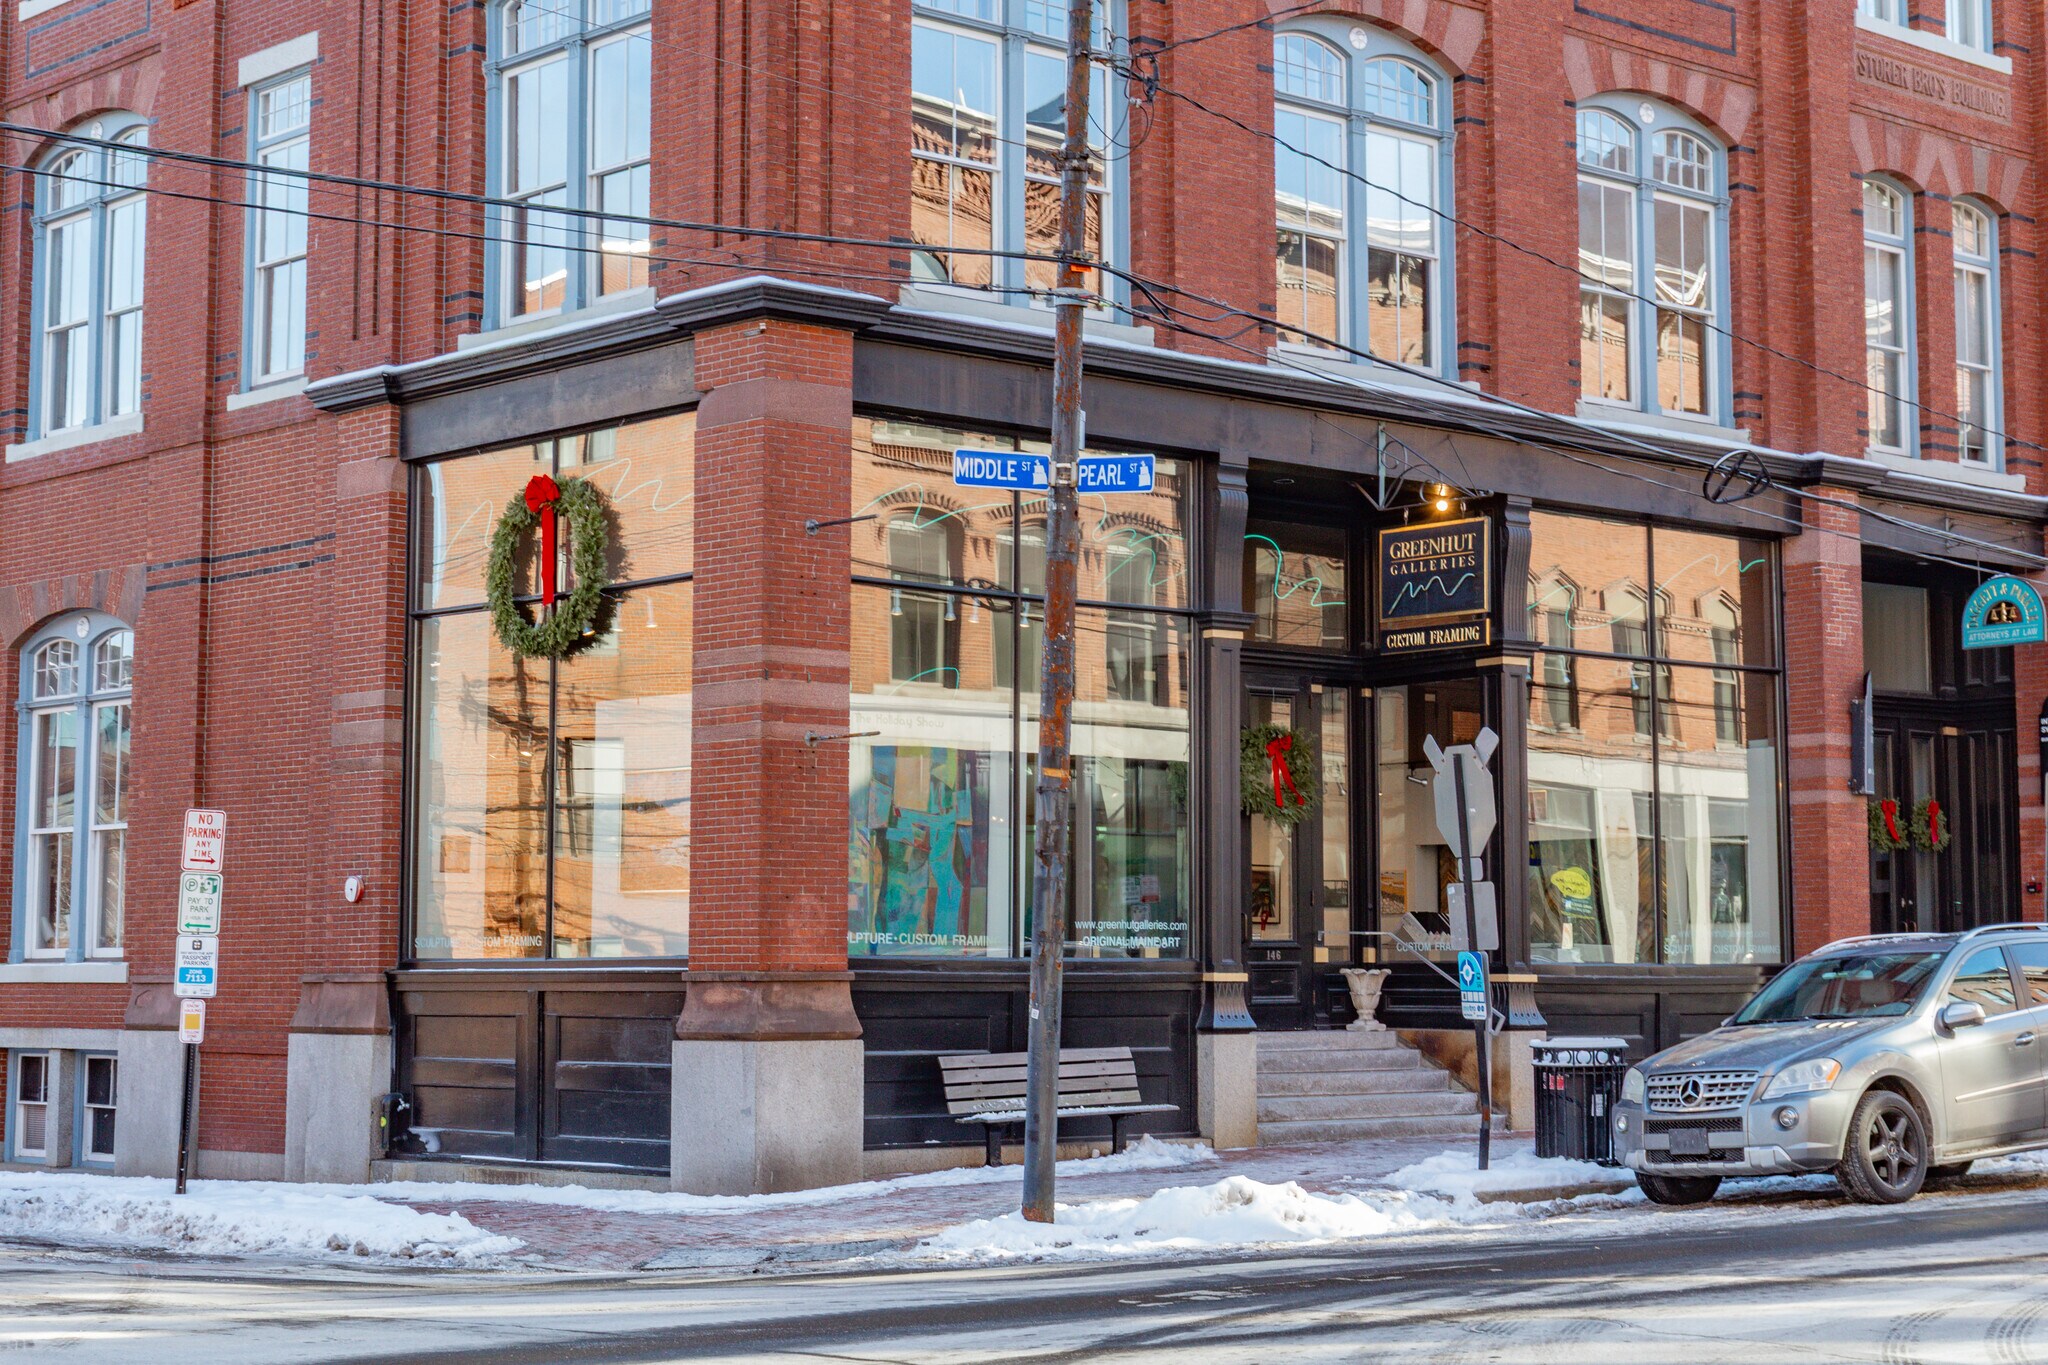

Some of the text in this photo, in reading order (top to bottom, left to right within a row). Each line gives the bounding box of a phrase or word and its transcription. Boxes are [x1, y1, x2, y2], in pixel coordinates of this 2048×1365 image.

[1857, 52, 1908, 90] STORER
[956, 456, 1031, 481] MIDDLE ST
[1078, 462, 1138, 486] PEARL ST
[1389, 532, 1477, 560] GREENHUT
[1390, 555, 1475, 576] GALLERIES
[1386, 625, 1480, 649] CUSTOM FRAMING
[1968, 628, 2038, 641] ATTORNEYS AT LAW
[875, 714, 913, 728] Holiday
[916, 716, 945, 728] Show
[198, 814, 213, 825] NO
[187, 827, 221, 839] PARKING
[195, 840, 212, 848] ANY
[193, 849, 212, 858] TIME
[204, 897, 213, 905] TO
[189, 905, 209, 913] PARK
[1074, 919, 1188, 932] www.greenhutgalleries.com
[503, 935, 543, 947] FRAMING
[847, 931, 893, 945] LPTURE
[899, 932, 948, 946] CUSTOM
[1082, 935, 1128, 947] ORIGINAL
[1266, 950, 1281, 960] 146
[185, 974, 207, 982] 7113
